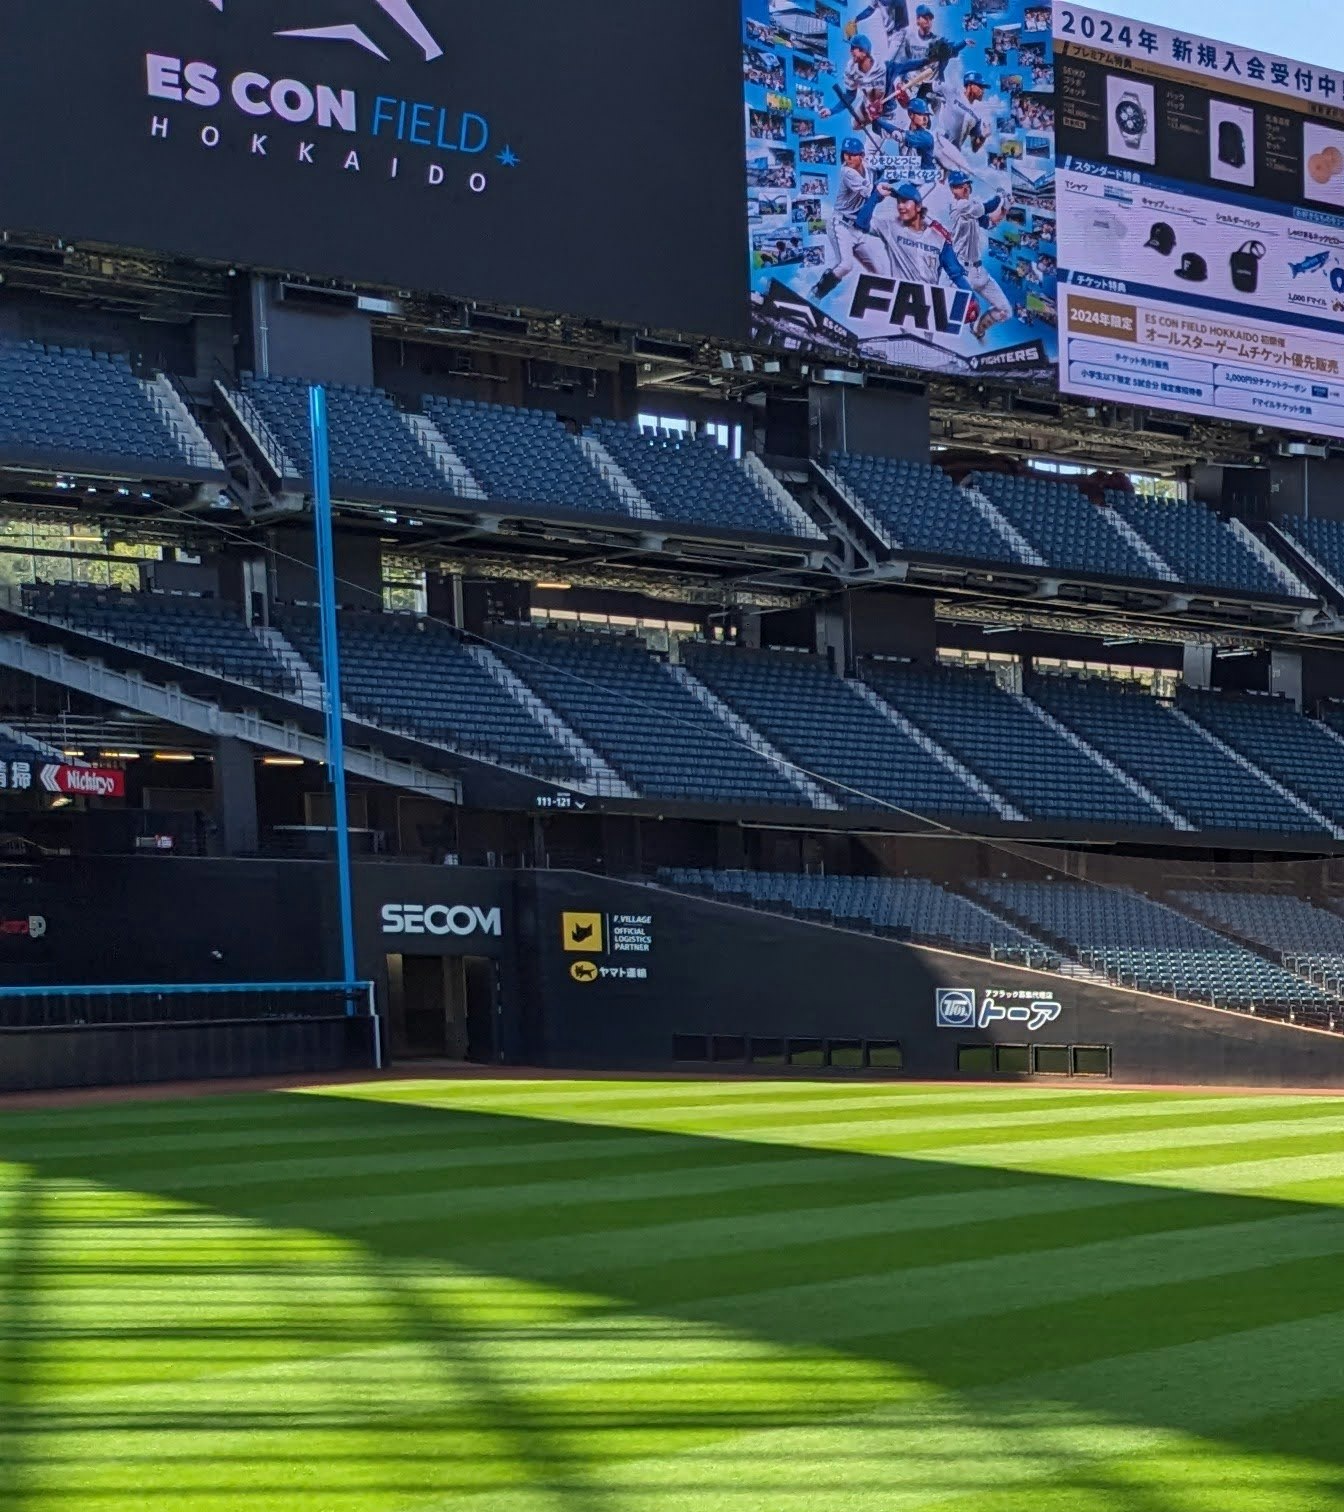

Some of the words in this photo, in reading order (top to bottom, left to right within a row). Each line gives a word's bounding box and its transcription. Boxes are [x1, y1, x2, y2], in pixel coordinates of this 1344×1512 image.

[1061, 10, 1159, 54] 2024年
[1072, 45, 1133, 70] プレミアム特典
[146, 53, 220, 107] ES
[232, 70, 357, 133] CON
[371, 96, 489, 154] FIELD
[151, 115, 486, 193] HOKKAIDO
[1075, 161, 1141, 184] スタンダード特典
[1076, 275, 1127, 293] チケット特典
[1070, 308, 1134, 331] 2024年限定
[1145, 314, 1157, 325] ES
[1159, 316, 1179, 329] CON
[1181, 319, 1207, 334] FIELD
[1209, 325, 1259, 343] HOKKAIDO
[980, 347, 1039, 366] FIGHTERS
[67, 771, 115, 796] Nichiryo
[536, 796, 571, 807] 111-121
[381, 904, 502, 936] SECOM
[614, 927, 646, 936] OFFICIAL
[614, 935, 652, 944] LOGISTICS
[614, 943, 650, 951] PARTNER
[599, 966, 648, 979] ヤマト運輸
